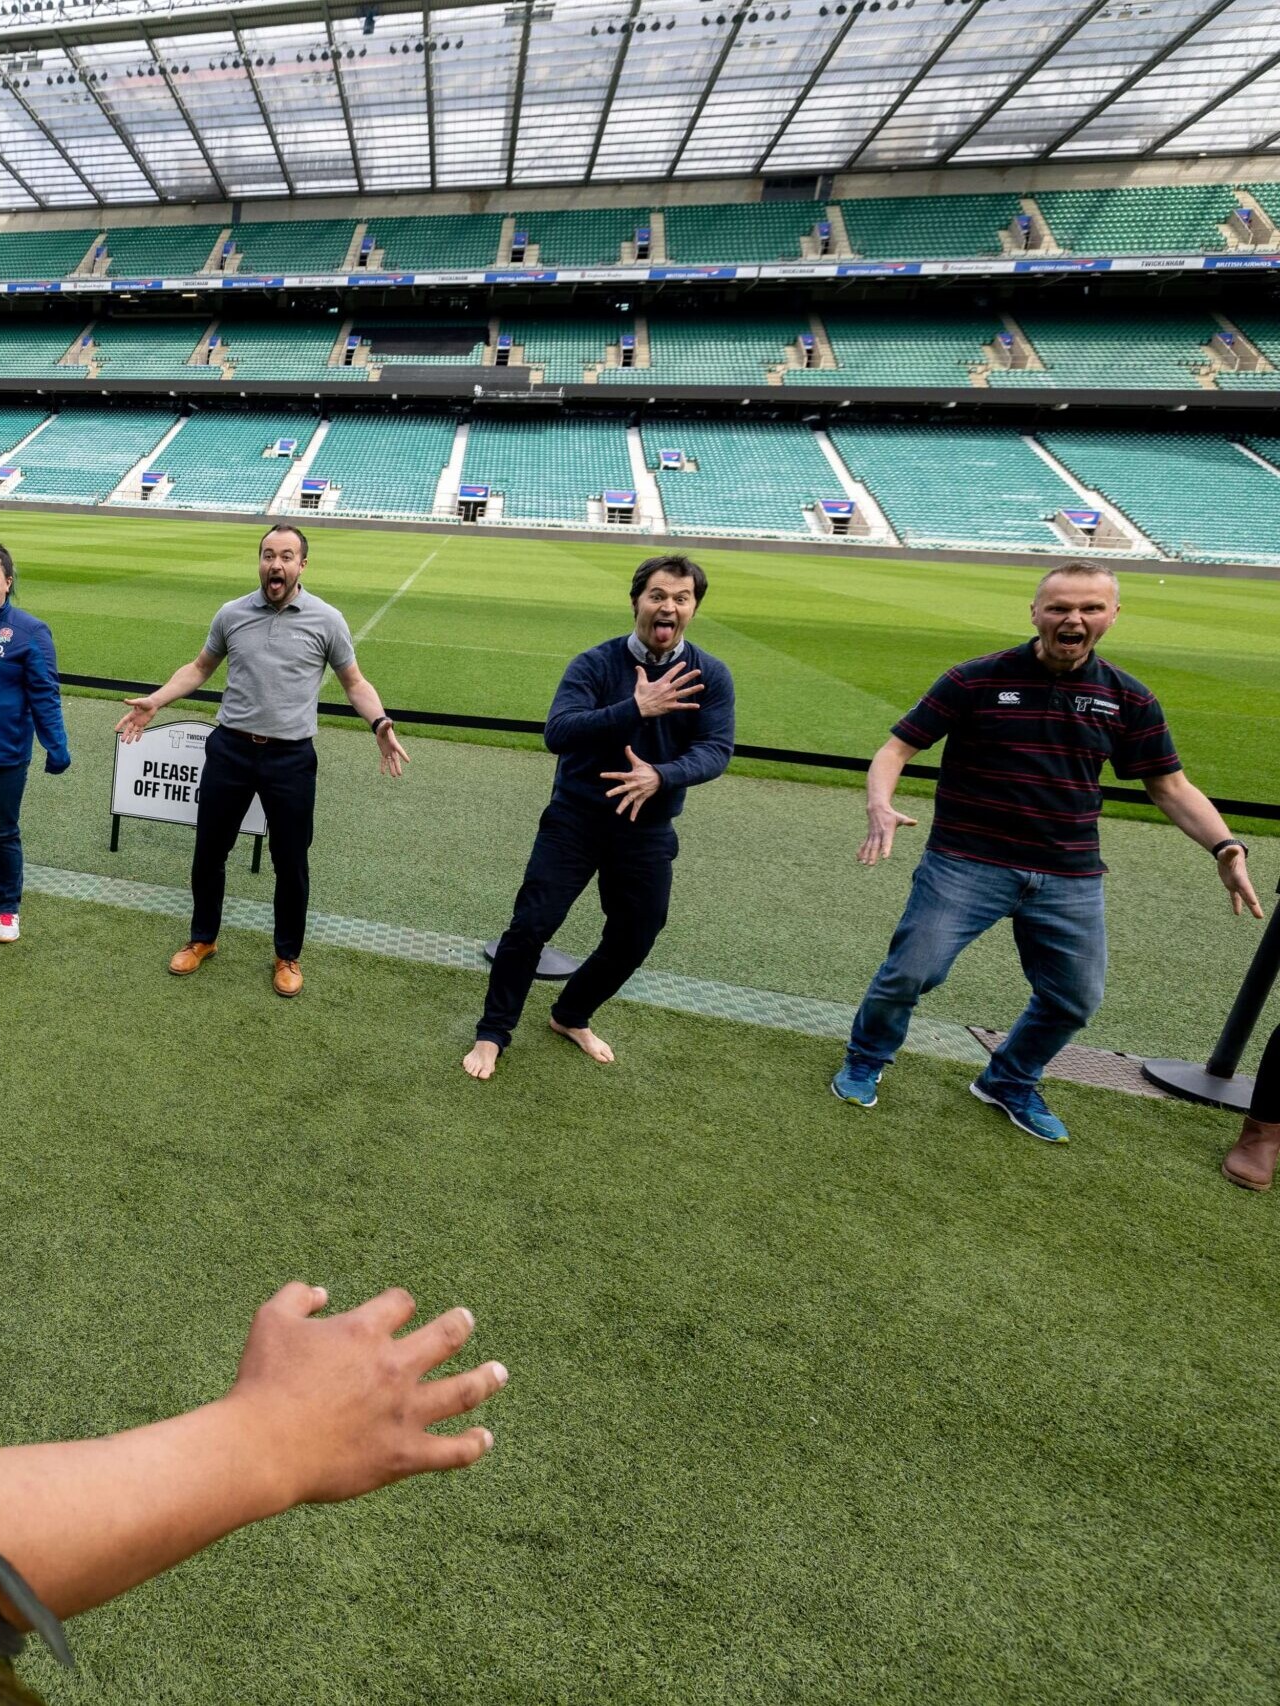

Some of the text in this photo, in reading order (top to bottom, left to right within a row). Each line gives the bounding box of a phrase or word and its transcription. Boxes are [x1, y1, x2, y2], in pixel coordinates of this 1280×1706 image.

[1141, 259, 1185, 267] TWICKENHAM
[143, 760, 199, 783] PLEASE
[134, 779, 160, 798] OFF
[163, 783, 191, 802] THE
